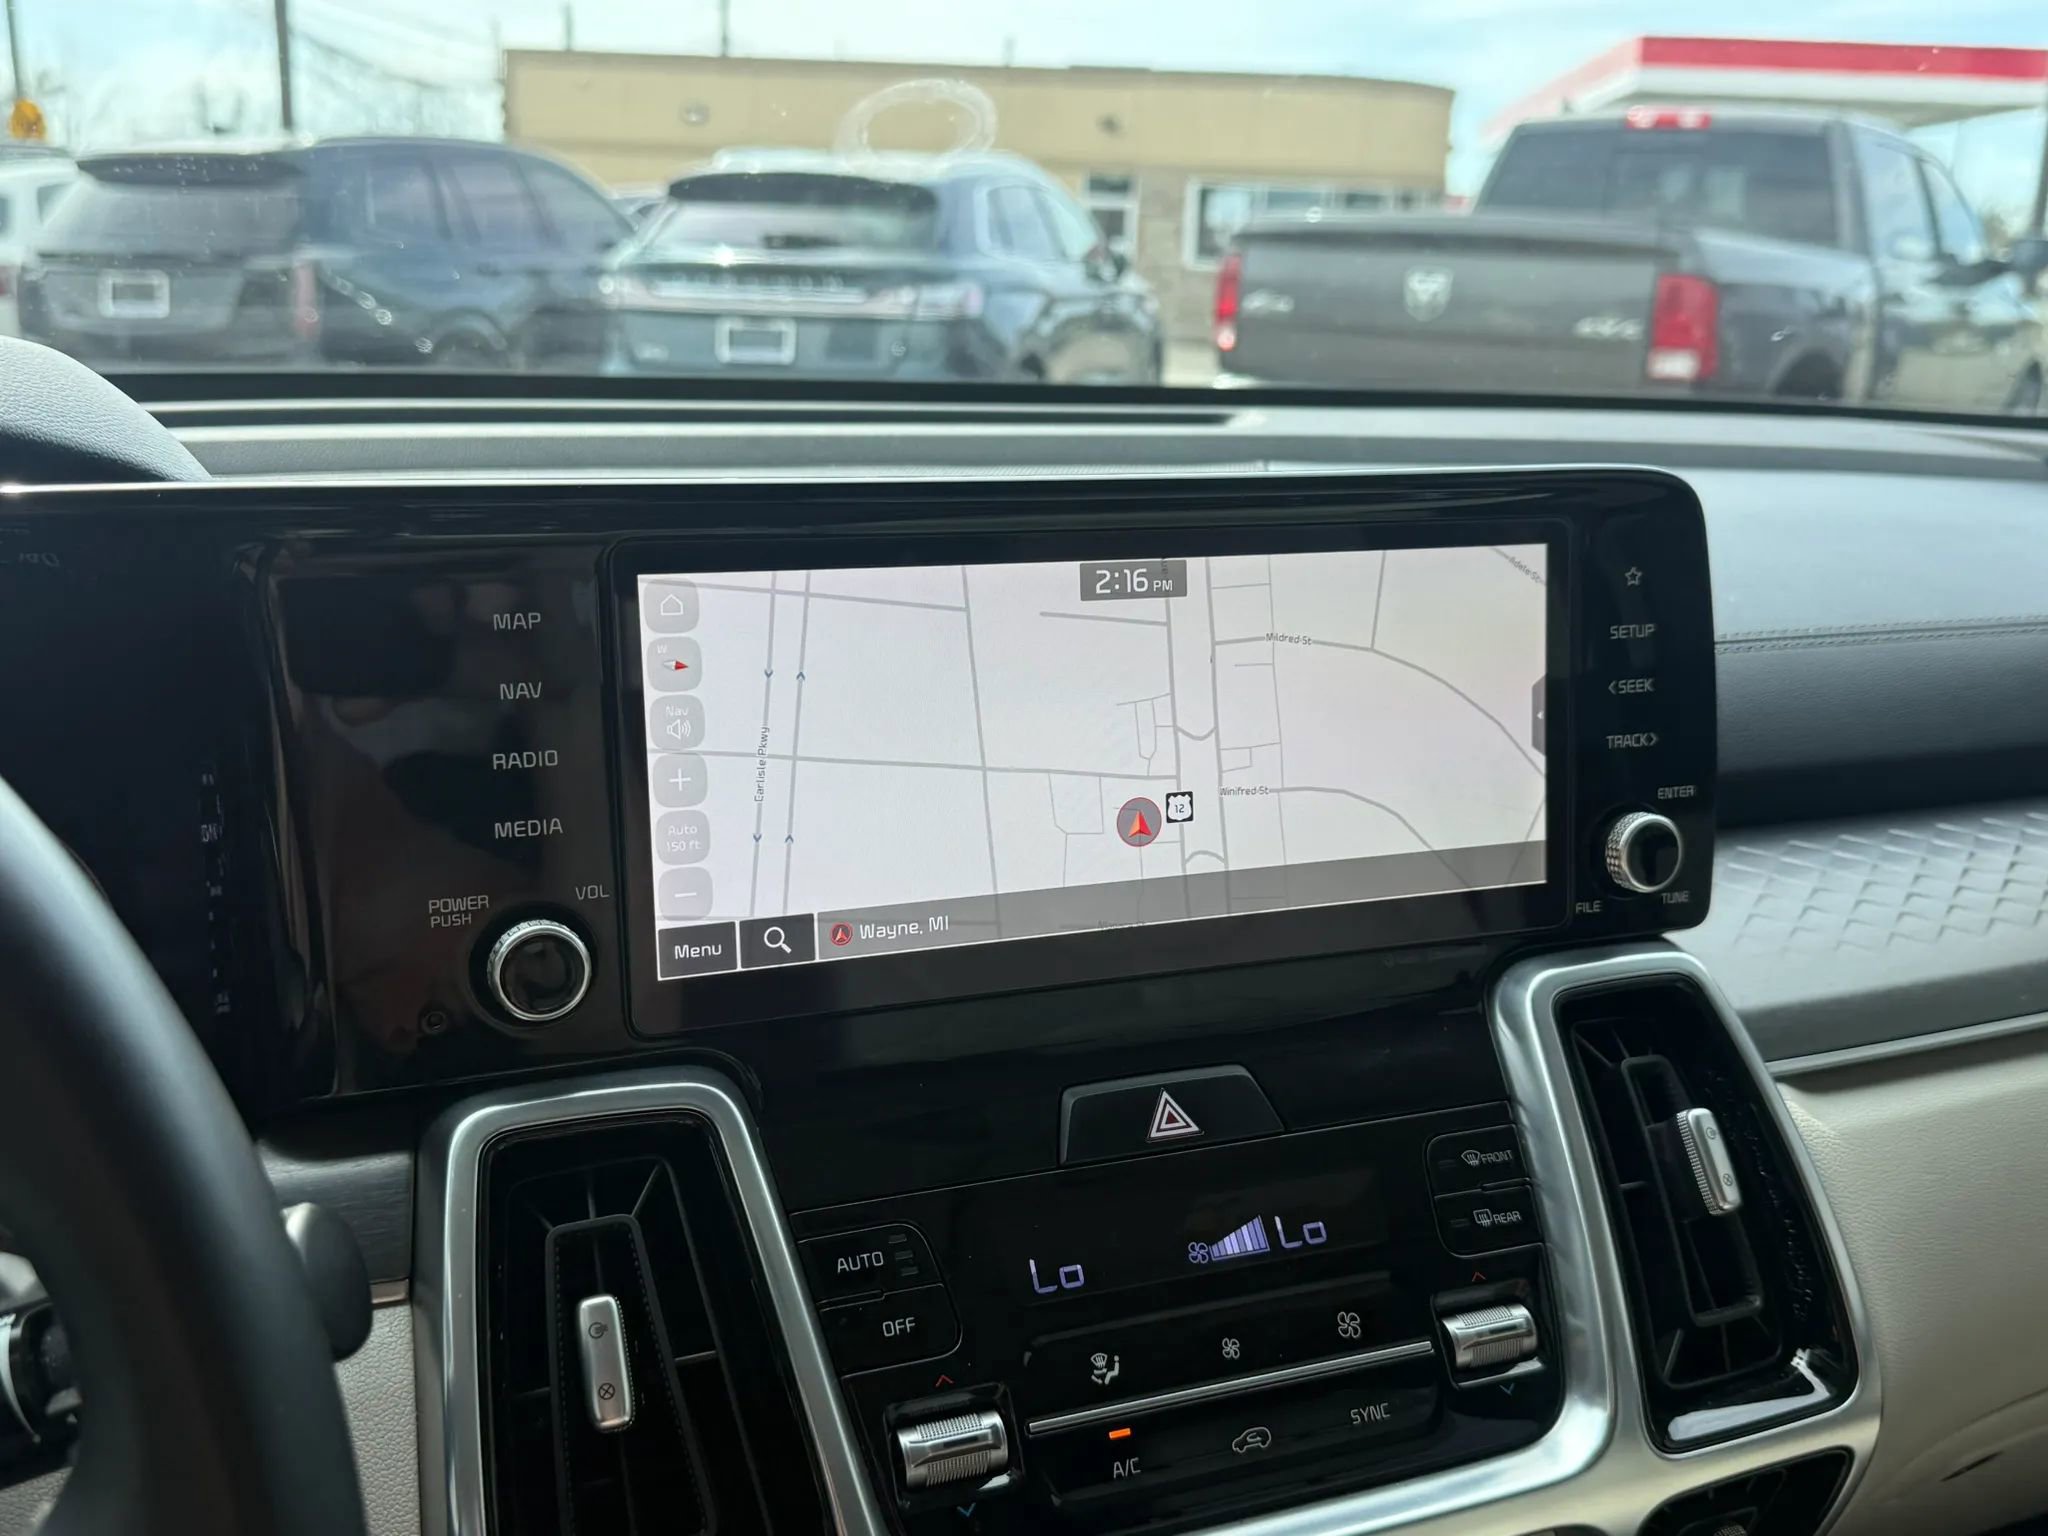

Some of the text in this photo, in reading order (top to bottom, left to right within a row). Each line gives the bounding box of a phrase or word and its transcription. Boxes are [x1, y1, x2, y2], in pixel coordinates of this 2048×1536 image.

[1095, 567, 1173, 594] 2:16 PM
[493, 612, 541, 630] MAP
[1266, 632, 1312, 646] Mildred St
[1609, 624, 1655, 639] SETUP
[499, 682, 542, 700] NAV
[666, 705, 688, 717] Nav
[493, 750, 558, 770] RADIO
[754, 725, 769, 802] Carlisle Pkwy
[1220, 785, 1269, 797] Winifred St
[1657, 785, 1695, 799] ENTER
[1175, 803, 1185, 815] 12
[494, 817, 563, 839] MEDIA
[668, 823, 698, 837] Auto
[666, 839, 701, 852] 150 ft
[575, 884, 609, 900] VOL
[1661, 890, 1689, 904] TUNE
[428, 895, 489, 913] POWER
[1575, 900, 1601, 914] FILE
[430, 913, 472, 928] PUSH
[929, 915, 949, 932] MI
[674, 941, 722, 959] Menu
[1481, 1149, 1514, 1165] FRONT
[1492, 1209, 1522, 1225] REAR
[1274, 1215, 1328, 1250] Lo
[836, 1250, 884, 1273] AUTO
[1028, 1257, 1085, 1295] Lo
[882, 1317, 916, 1338] OFF
[1350, 1403, 1392, 1425] SYNC
[1112, 1458, 1142, 1479] A/C
